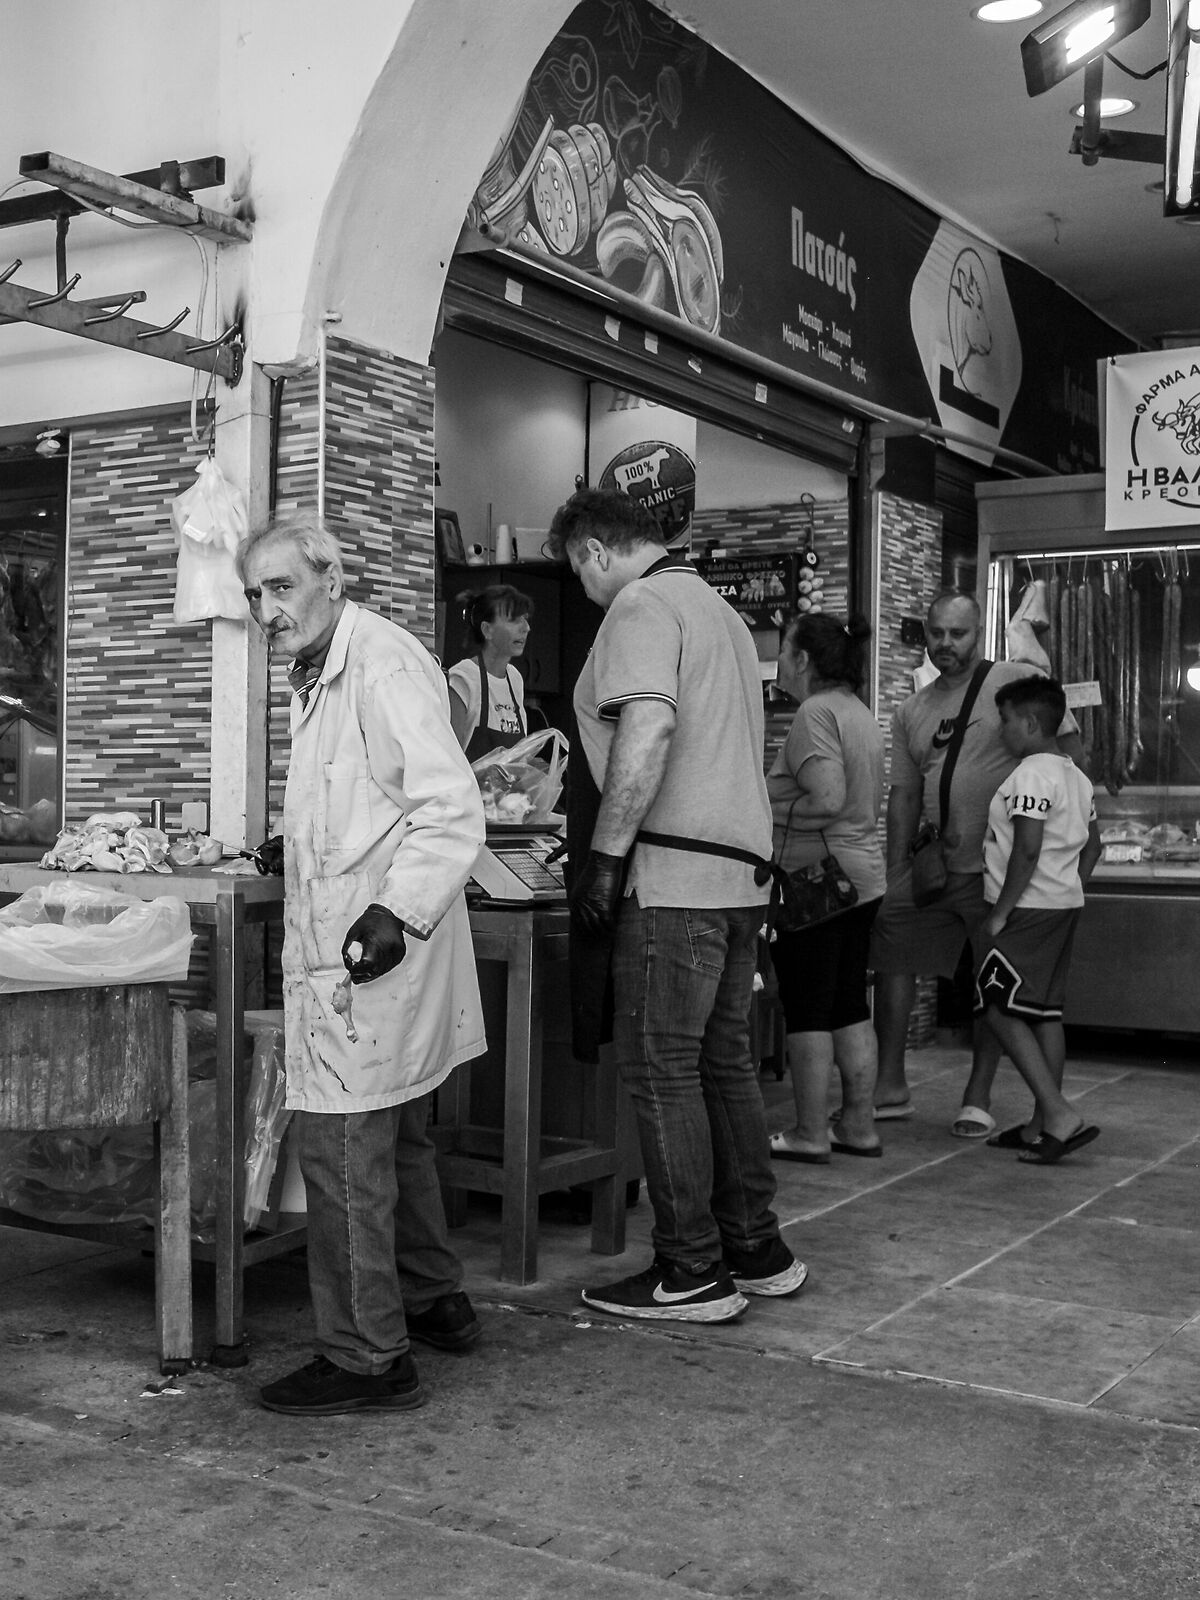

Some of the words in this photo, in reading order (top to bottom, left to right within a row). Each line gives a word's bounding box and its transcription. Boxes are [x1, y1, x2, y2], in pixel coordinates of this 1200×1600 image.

[791, 206, 858, 312] Πατσάς
[1135, 369, 1186, 414] ΦΑΡΜΑ
[625, 460, 654, 481] 100%
[639, 487, 676, 508] GANIC
[1124, 485, 1200, 501] ΚΡΕΟ
